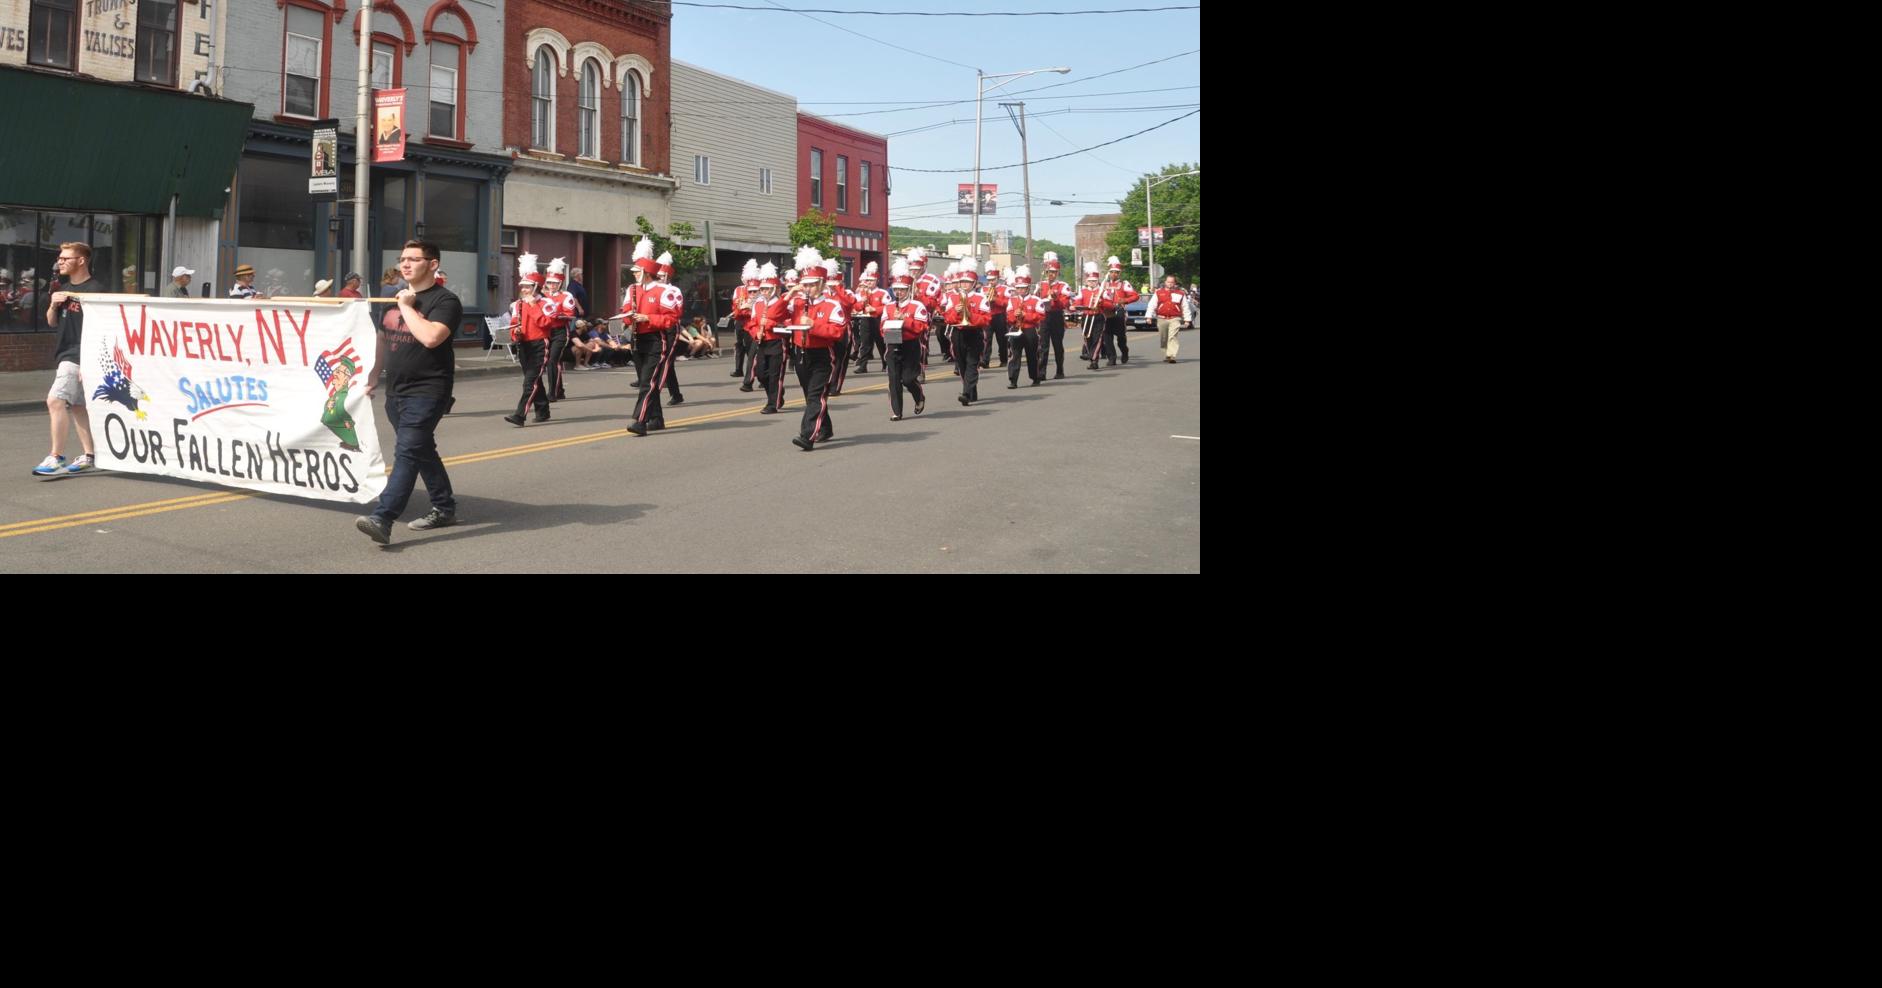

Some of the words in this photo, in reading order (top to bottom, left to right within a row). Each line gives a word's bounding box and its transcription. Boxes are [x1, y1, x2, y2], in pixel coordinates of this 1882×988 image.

[86, 0, 136, 18] TRUN
[114, 13, 131, 30] &
[84, 29, 135, 60] VALISES
[119, 304, 251, 366] WAVERLY,
[255, 309, 311, 366] NY
[178, 375, 268, 414] SALUTES
[104, 413, 166, 467] OUR
[173, 418, 262, 480] FALLEN
[266, 430, 359, 494] HEROS
